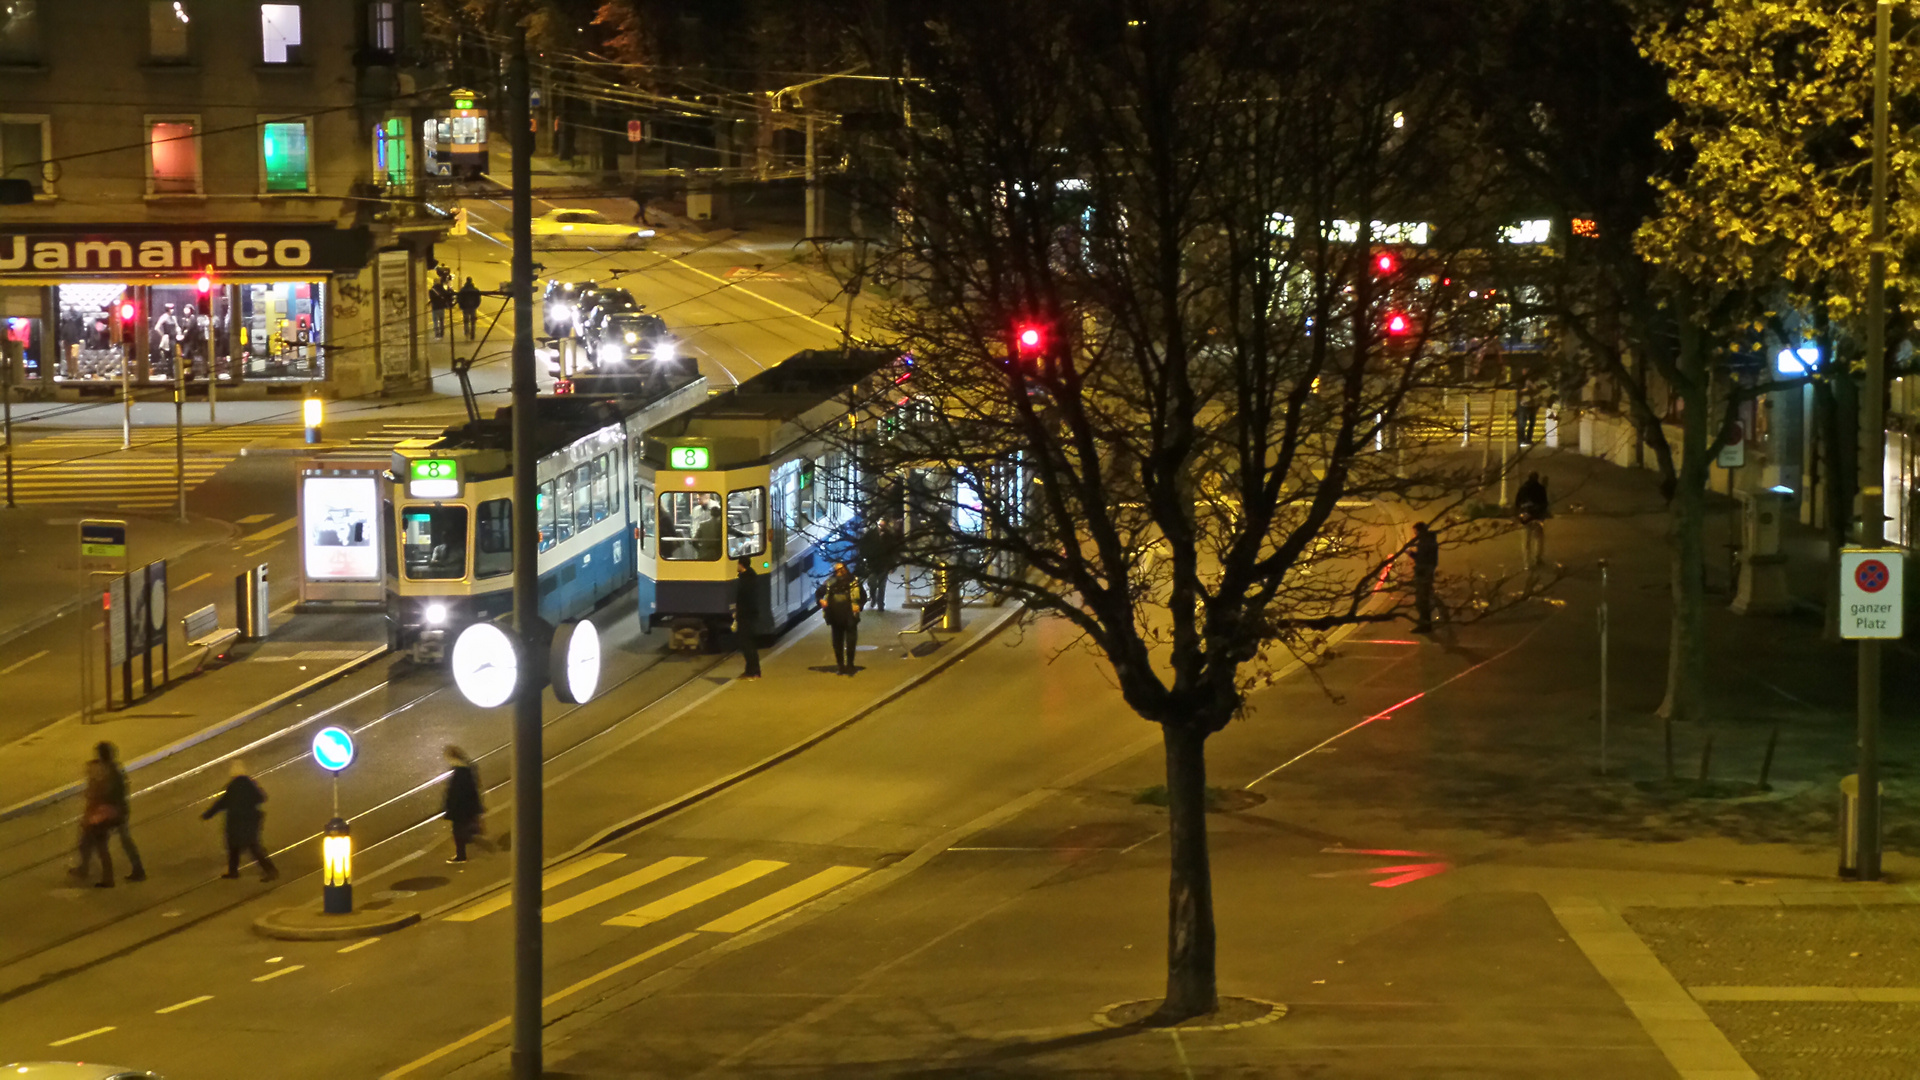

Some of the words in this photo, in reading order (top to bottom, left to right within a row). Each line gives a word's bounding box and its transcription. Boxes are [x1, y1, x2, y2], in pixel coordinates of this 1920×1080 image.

[0, 233, 311, 270] Jamarico
[684, 449, 696, 466] 8
[428, 461, 440, 478] 8
[1851, 604, 1892, 616] ganzer
[1856, 617, 1887, 629] Platz
